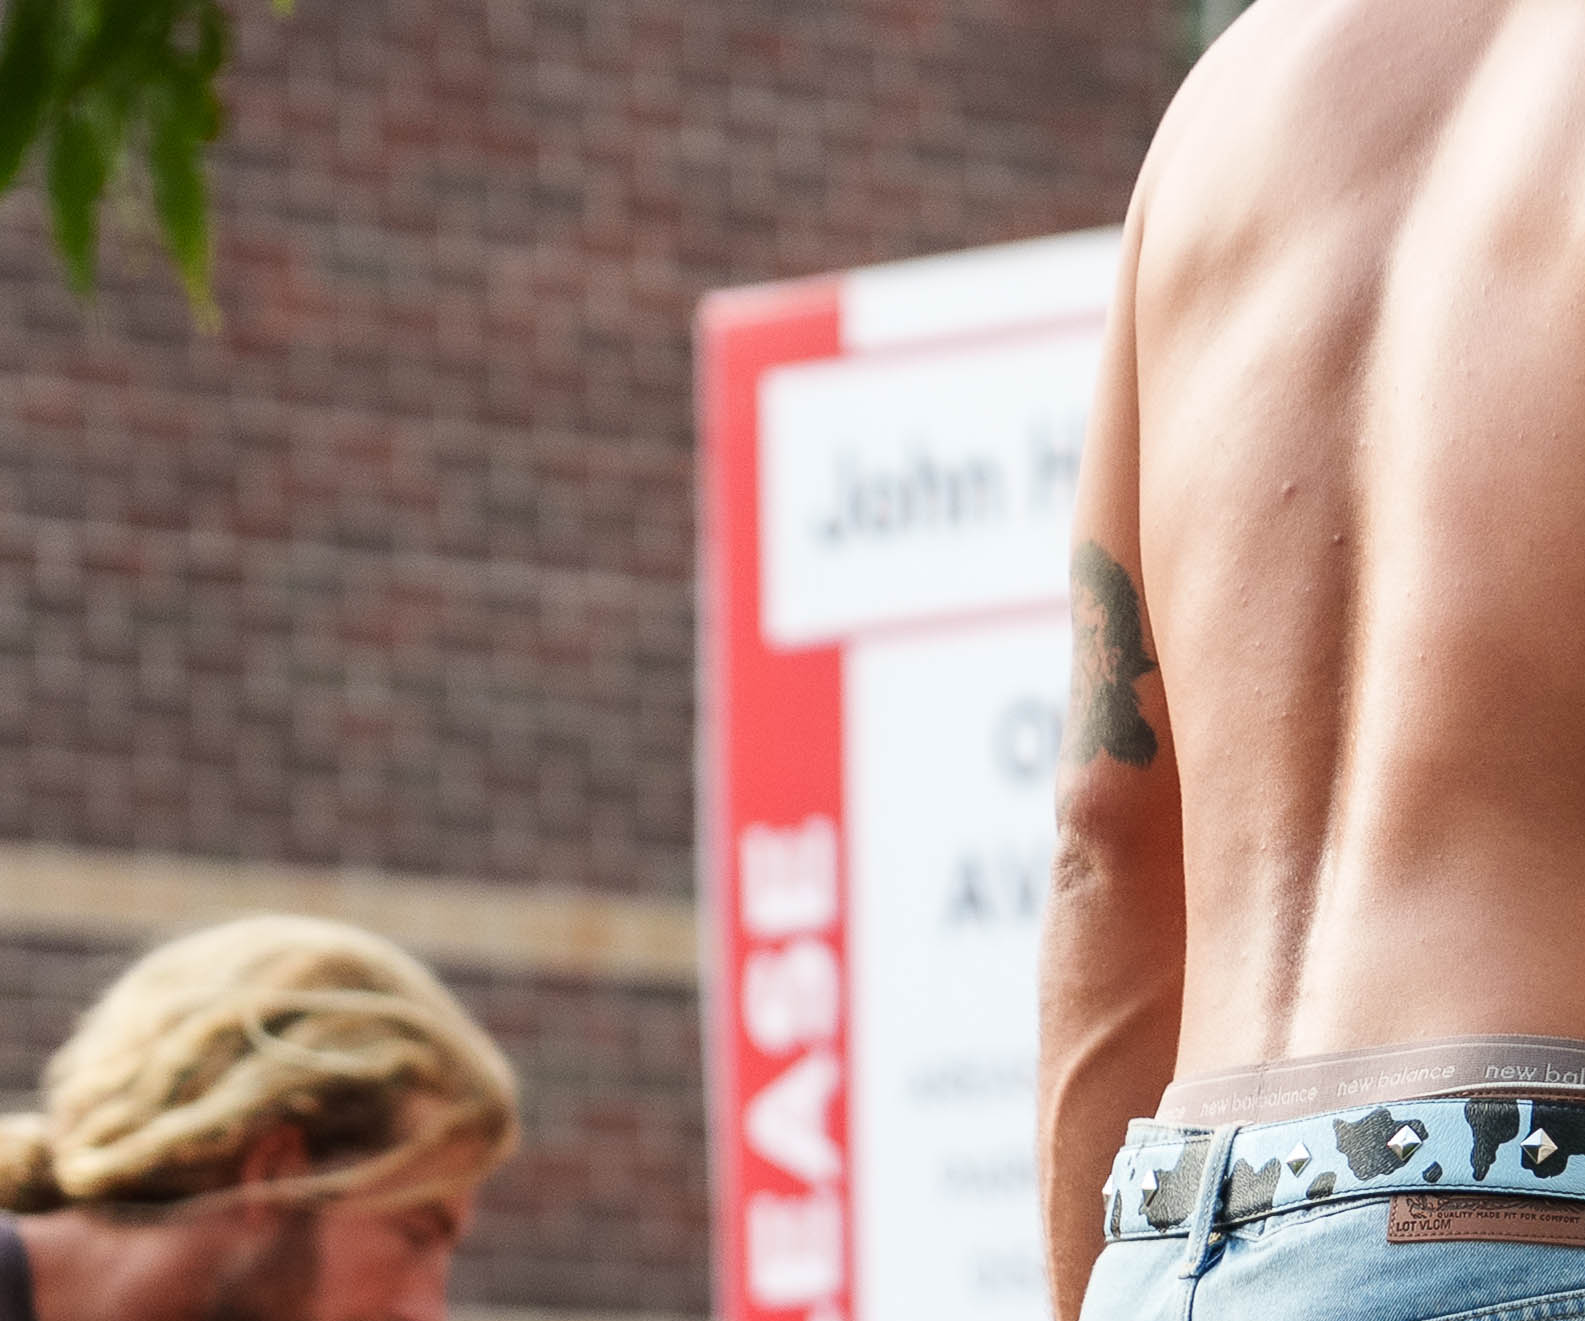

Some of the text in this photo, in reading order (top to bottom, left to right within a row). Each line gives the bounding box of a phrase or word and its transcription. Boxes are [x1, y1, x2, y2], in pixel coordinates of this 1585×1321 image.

[1336, 1079, 1374, 1097] new
[1378, 1064, 1456, 1089] balance
[1485, 1063, 1537, 1081] new
[1437, 1211, 1473, 1219] QUALITY
[1396, 1221, 1416, 1232] LOT
